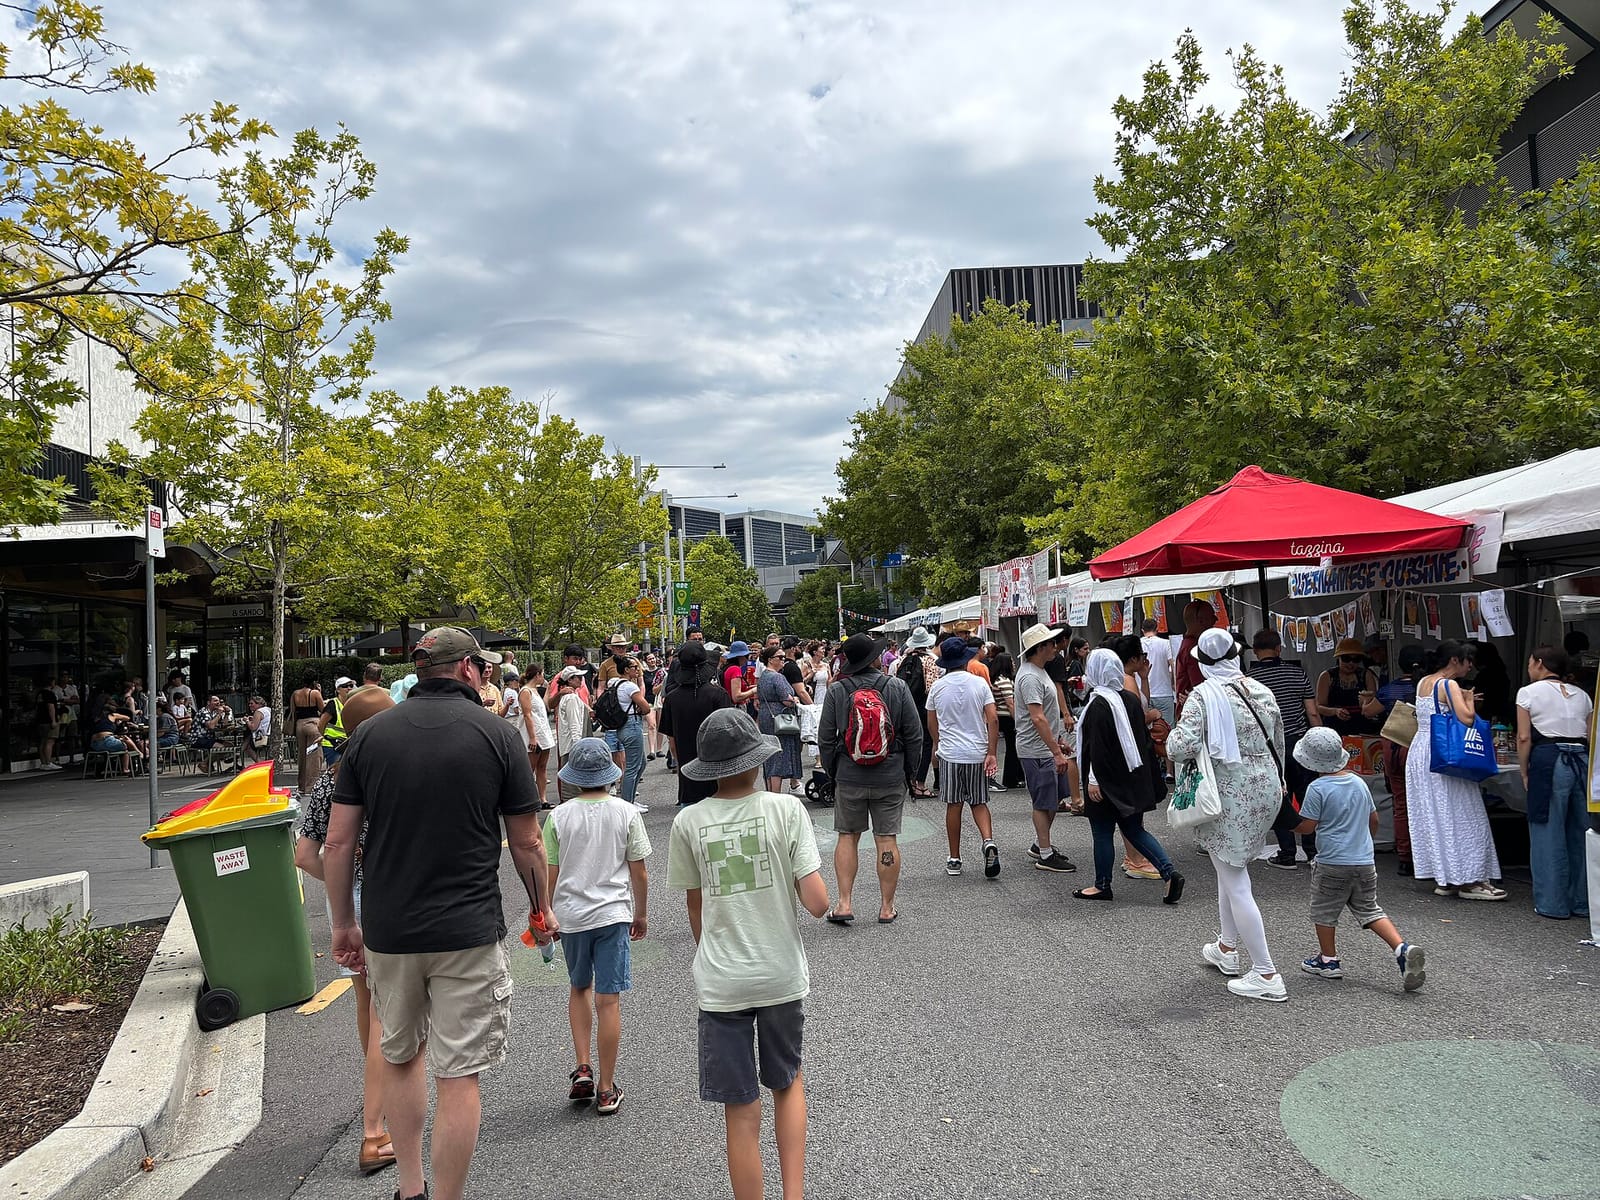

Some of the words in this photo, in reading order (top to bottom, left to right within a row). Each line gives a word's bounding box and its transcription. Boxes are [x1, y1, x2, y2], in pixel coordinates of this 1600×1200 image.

[1290, 541, 1345, 558] tazzina
[1384, 551, 1459, 588] CUISINE
[1464, 742, 1484, 752] ALDI
[216, 850, 246, 863] WASTE
[220, 859, 244, 871] AWAY
